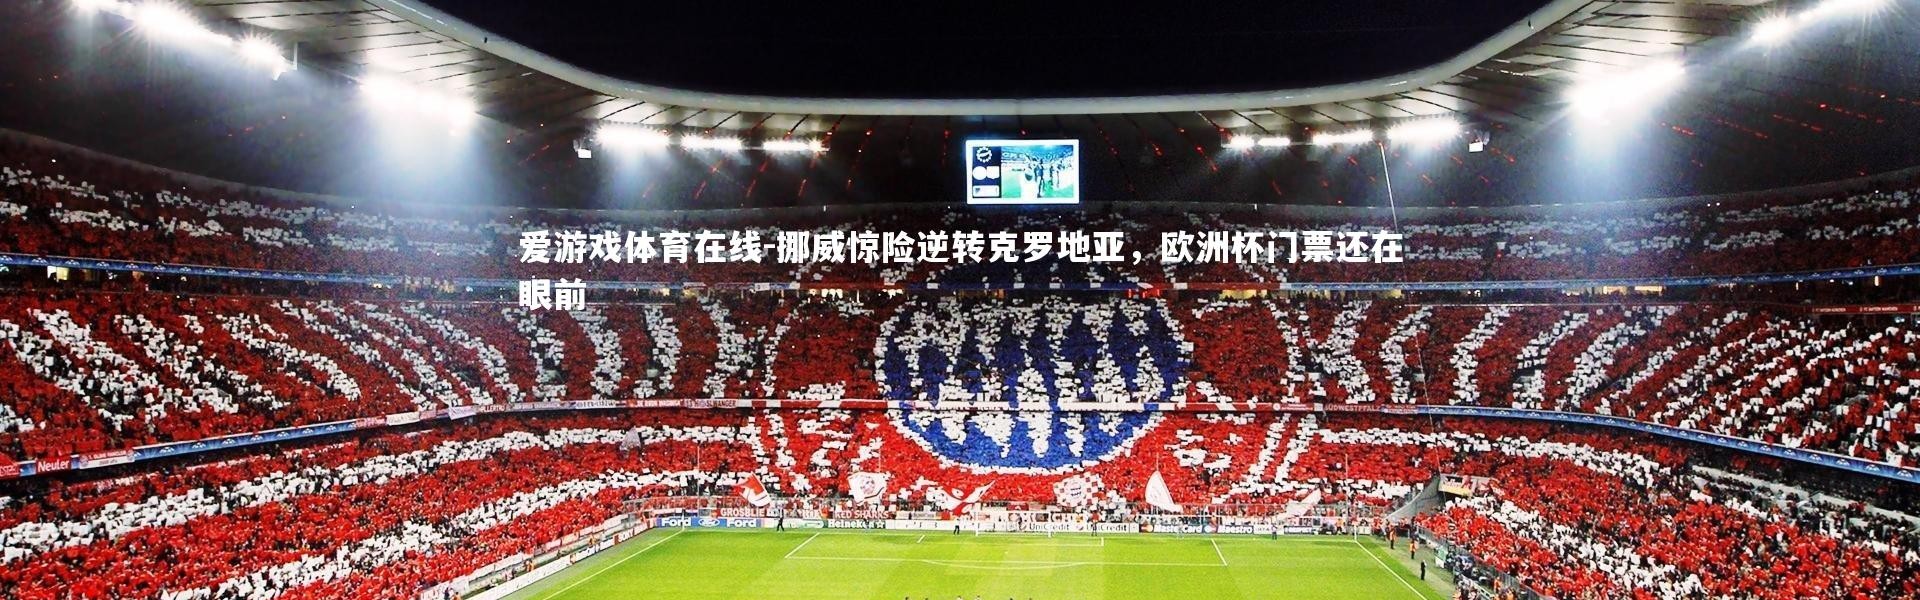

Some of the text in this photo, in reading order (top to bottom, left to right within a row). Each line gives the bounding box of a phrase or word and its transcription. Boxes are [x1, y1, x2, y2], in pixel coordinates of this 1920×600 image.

[37, 459, 70, 473] Neuler
[834, 510, 889, 519] RED SHARKS
[661, 517, 691, 527] Ford
[726, 518, 757, 527] Ford
